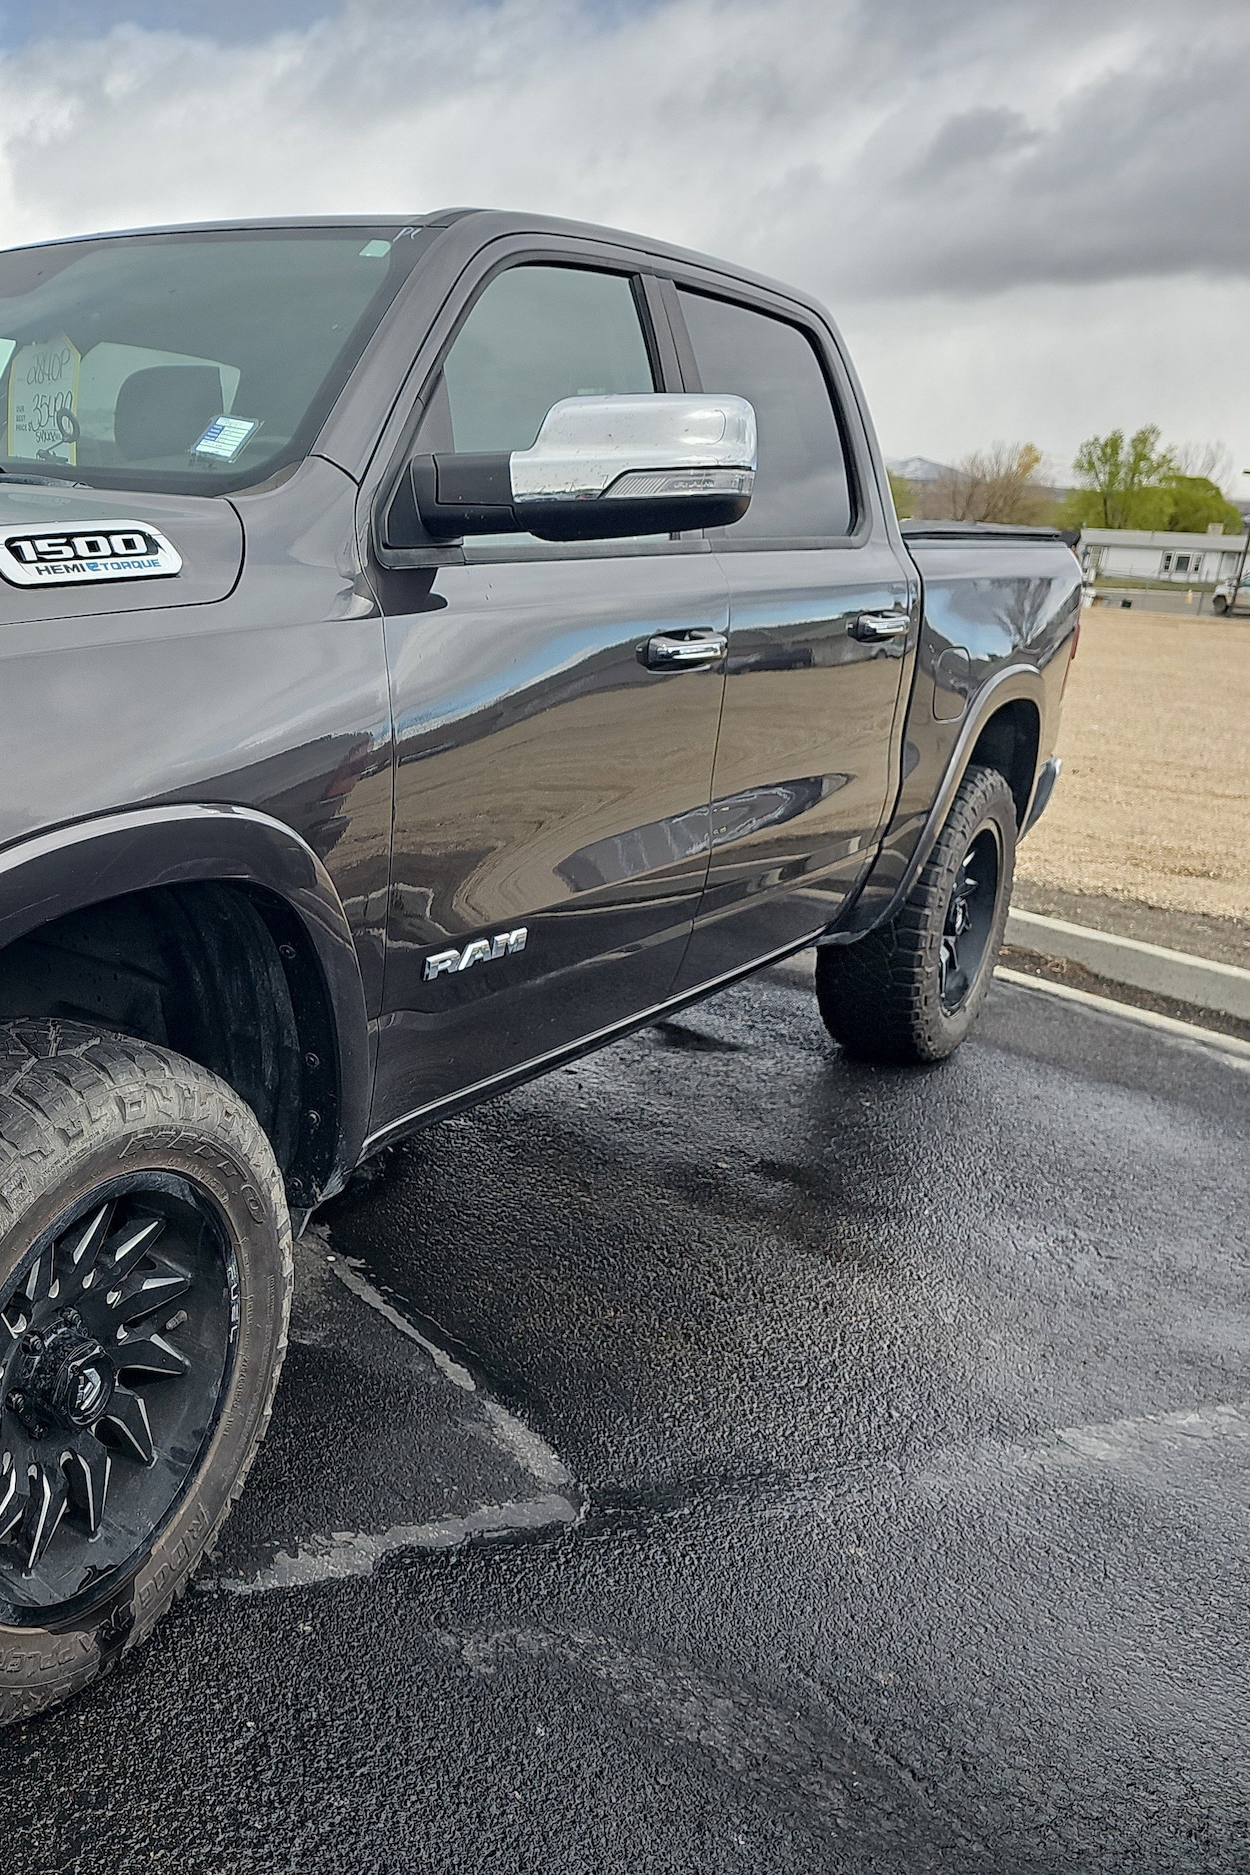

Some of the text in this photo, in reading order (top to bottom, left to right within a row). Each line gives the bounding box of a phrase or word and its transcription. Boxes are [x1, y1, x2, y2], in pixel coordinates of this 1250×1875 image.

[10, 533, 149, 562] 1500
[35, 562, 87, 576] HEMI
[421, 926, 529, 982] RAM
